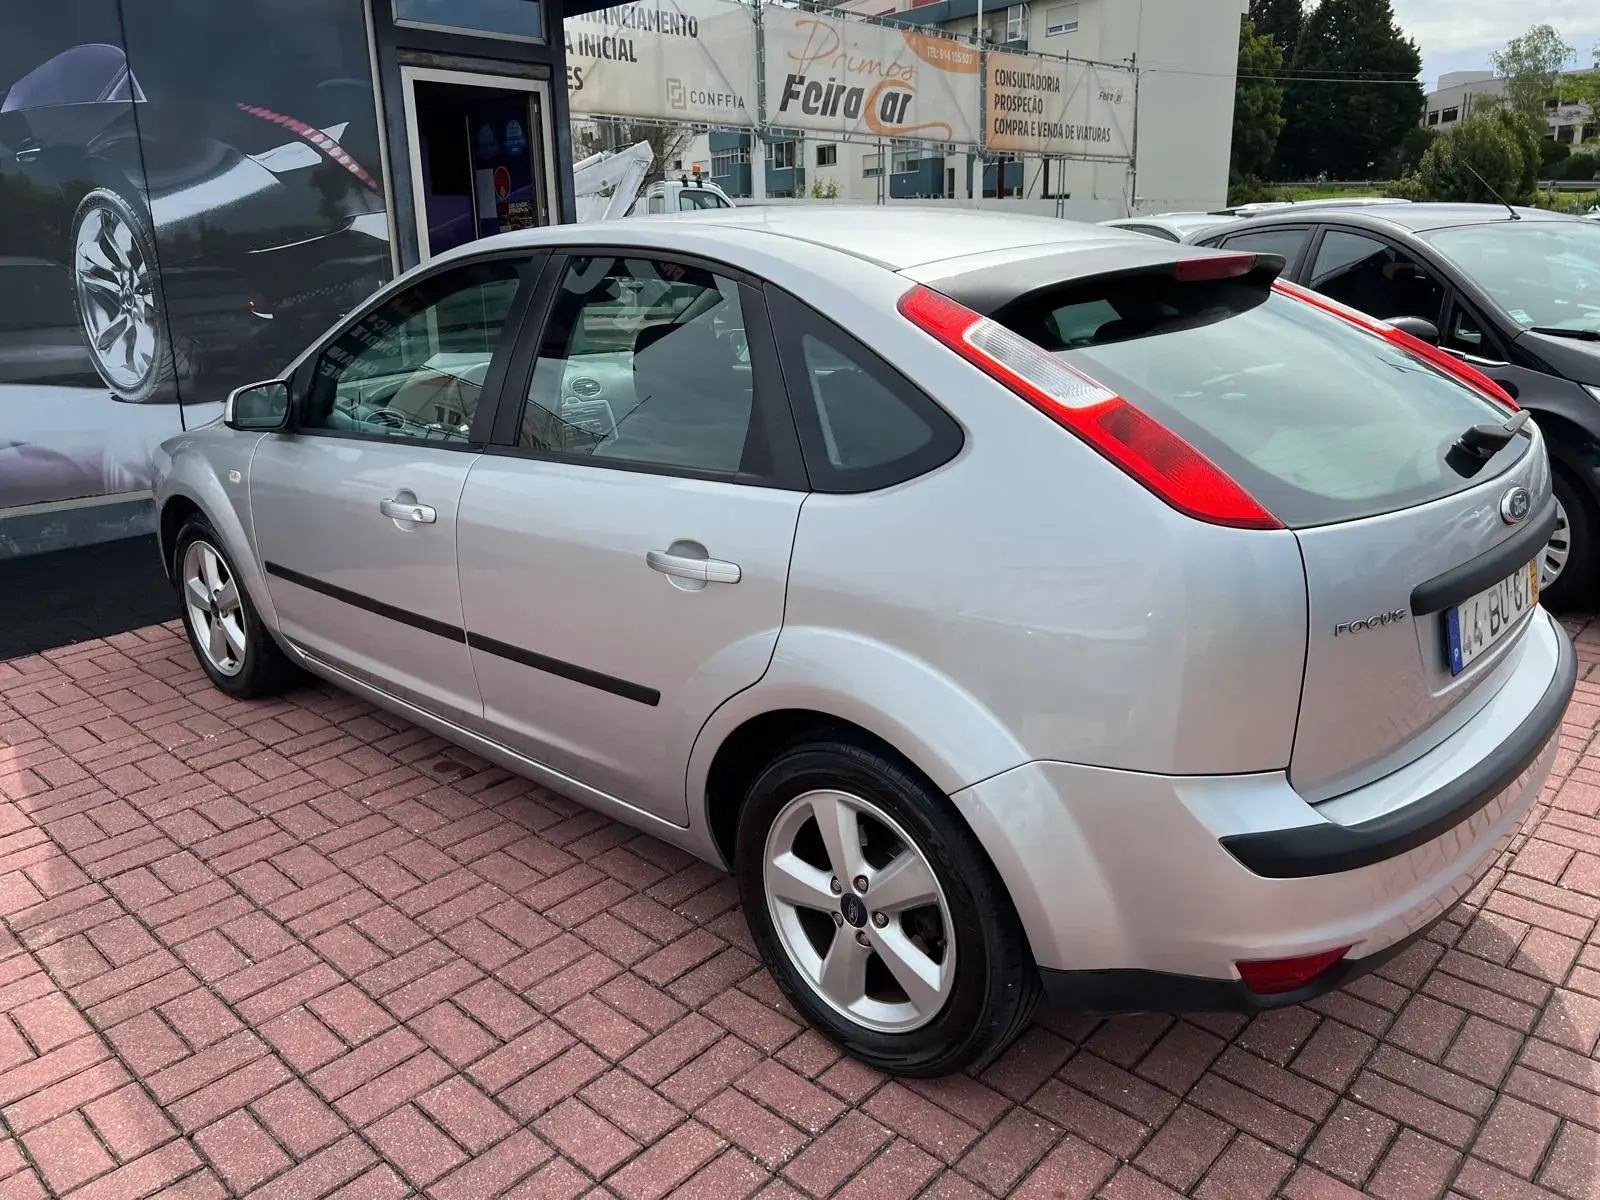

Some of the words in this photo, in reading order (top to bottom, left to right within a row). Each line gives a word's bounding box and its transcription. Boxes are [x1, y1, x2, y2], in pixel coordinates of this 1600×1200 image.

[571, 4, 698, 38] NANCIAMENTO
[578, 32, 637, 62] INICIAL
[787, 19, 919, 81] Primos
[994, 69, 1060, 93] CONSULTADORIA
[690, 90, 745, 109] CONFFIA
[994, 93, 1043, 116] PROSPEÇÃO
[994, 118, 1029, 136] COMPRA
[1031, 121, 1036, 137] E
[1038, 122, 1063, 139] VENDA
[1065, 124, 1075, 140] DE
[1076, 125, 1111, 143] VIATURAS
[1334, 608, 1407, 637] FOCUS
